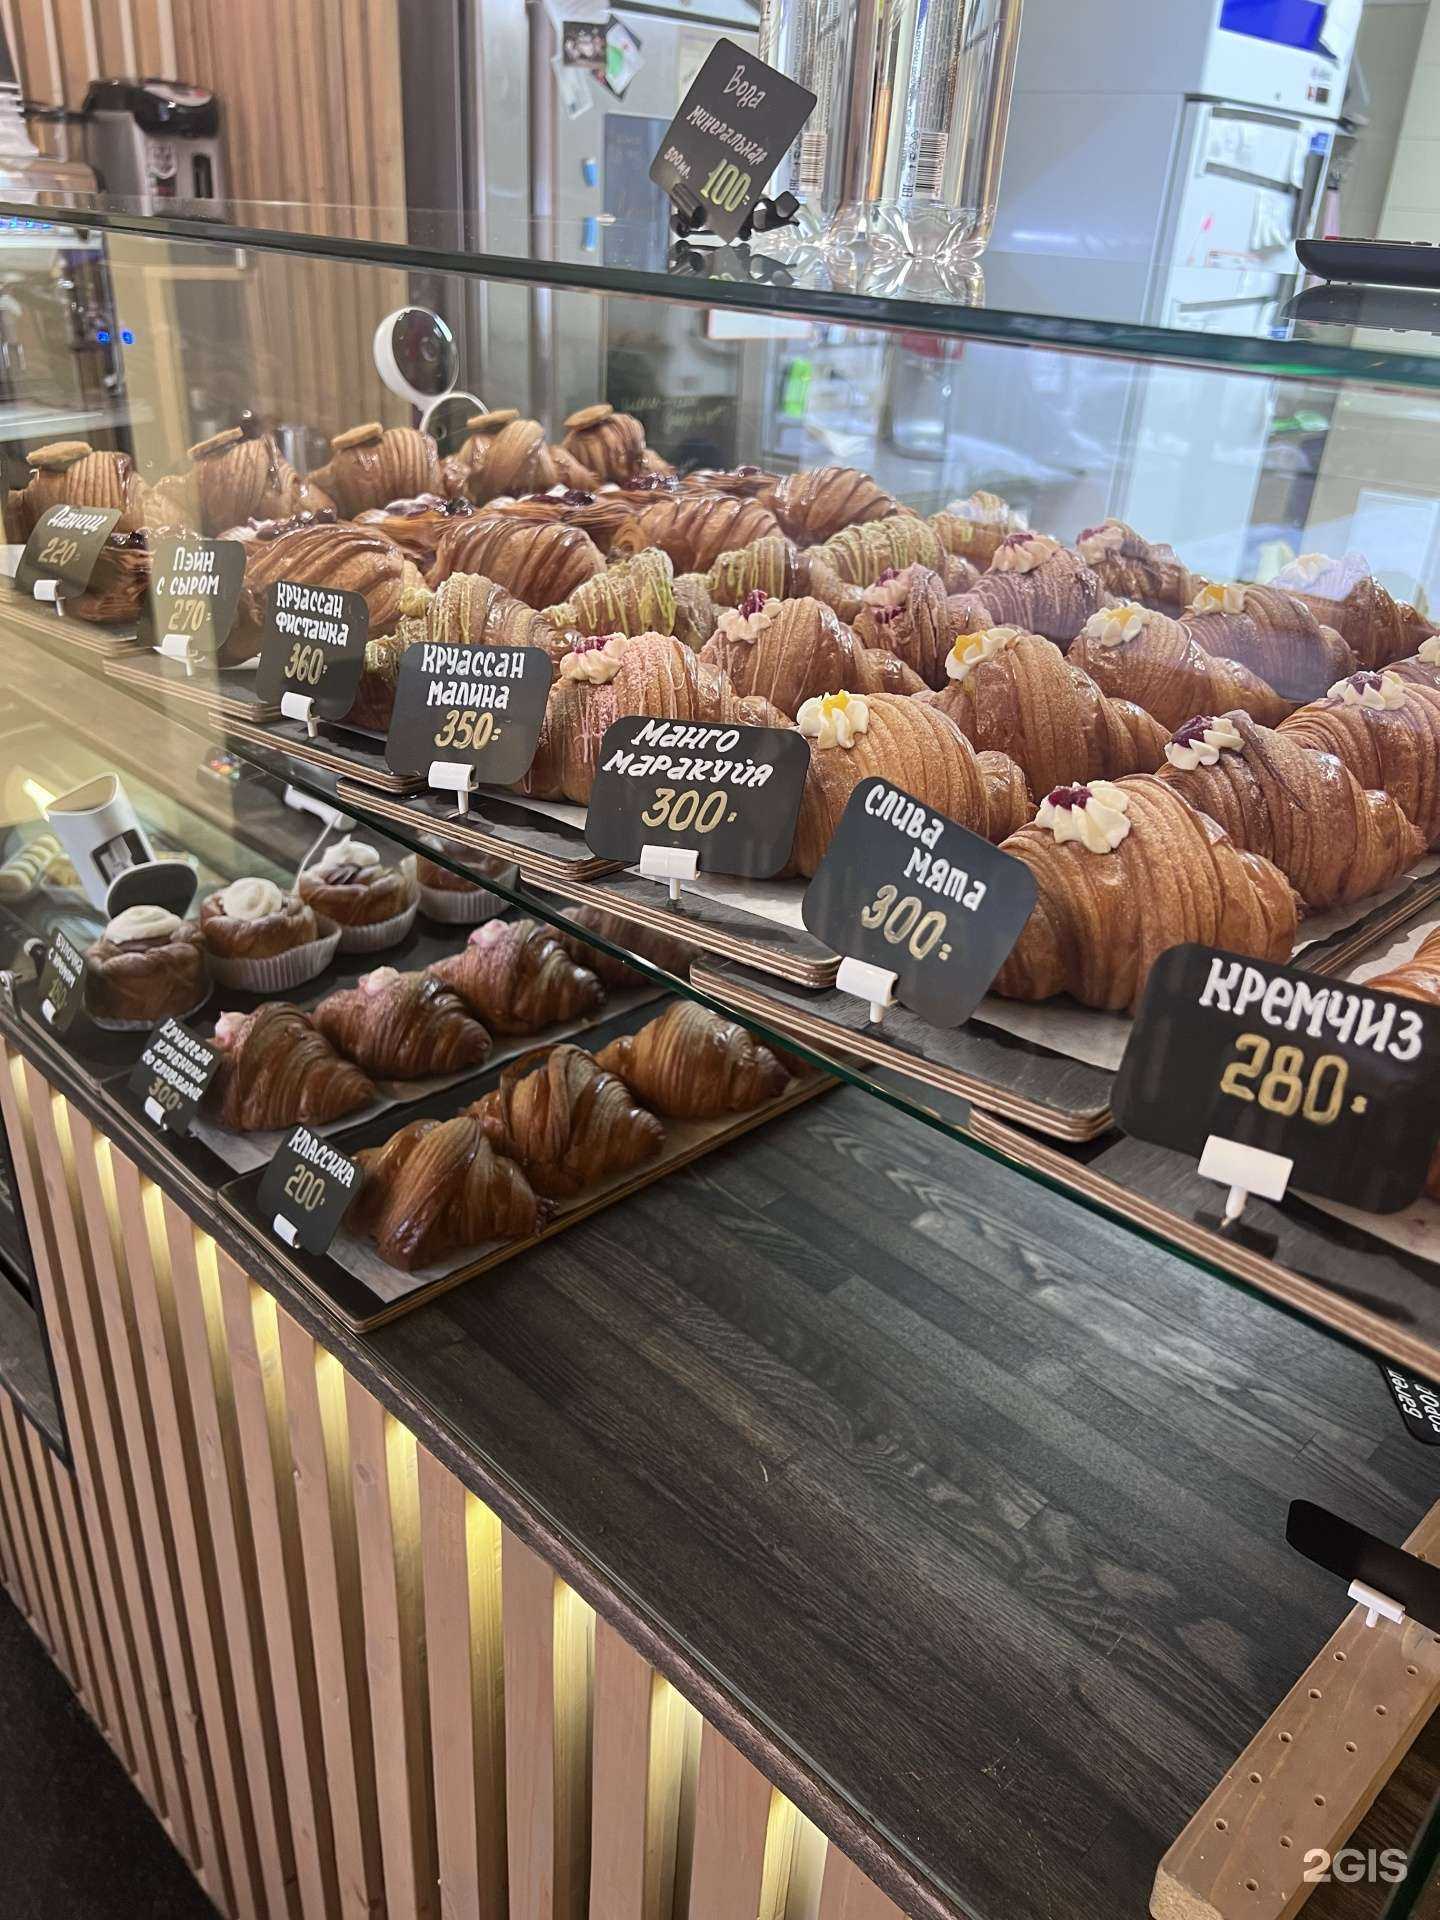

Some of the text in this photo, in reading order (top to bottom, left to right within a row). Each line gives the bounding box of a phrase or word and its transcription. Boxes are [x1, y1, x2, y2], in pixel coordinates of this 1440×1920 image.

[723, 64, 766, 109] Вода
[686, 105, 768, 166] минеральная
[172, 546, 215, 573] Пэйн
[169, 575, 220, 597] сыром
[426, 680, 511, 710] малина
